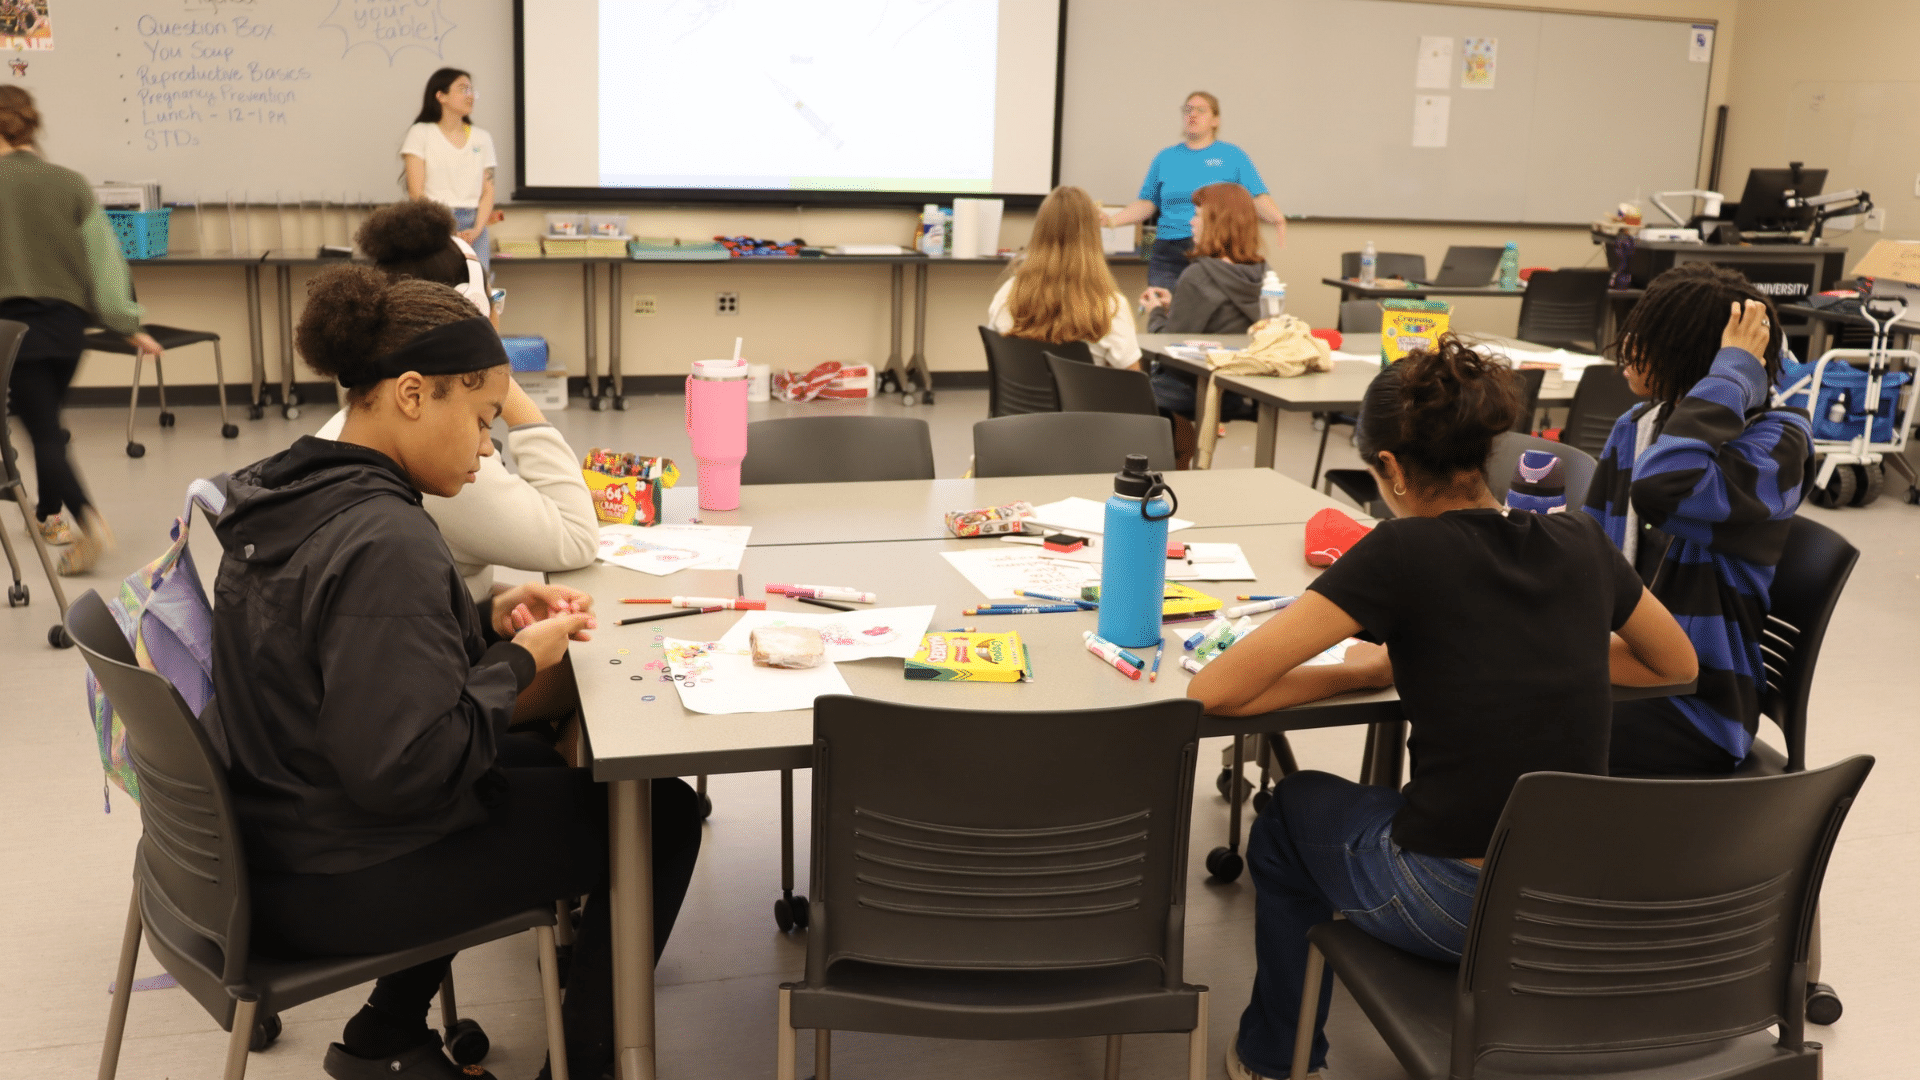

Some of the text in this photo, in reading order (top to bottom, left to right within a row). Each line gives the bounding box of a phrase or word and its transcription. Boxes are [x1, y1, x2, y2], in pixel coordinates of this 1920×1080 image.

[137, 14, 276, 40] Question Box
[353, 4, 411, 29] your
[374, 10, 439, 41] table!
[143, 39, 235, 62] You Soup
[136, 61, 312, 89] Reproductive Basics
[137, 84, 297, 109] Pregnancy Prevention
[142, 104, 203, 125] Lunch
[144, 128, 201, 151] STDs
[605, 486, 624, 502] 64
